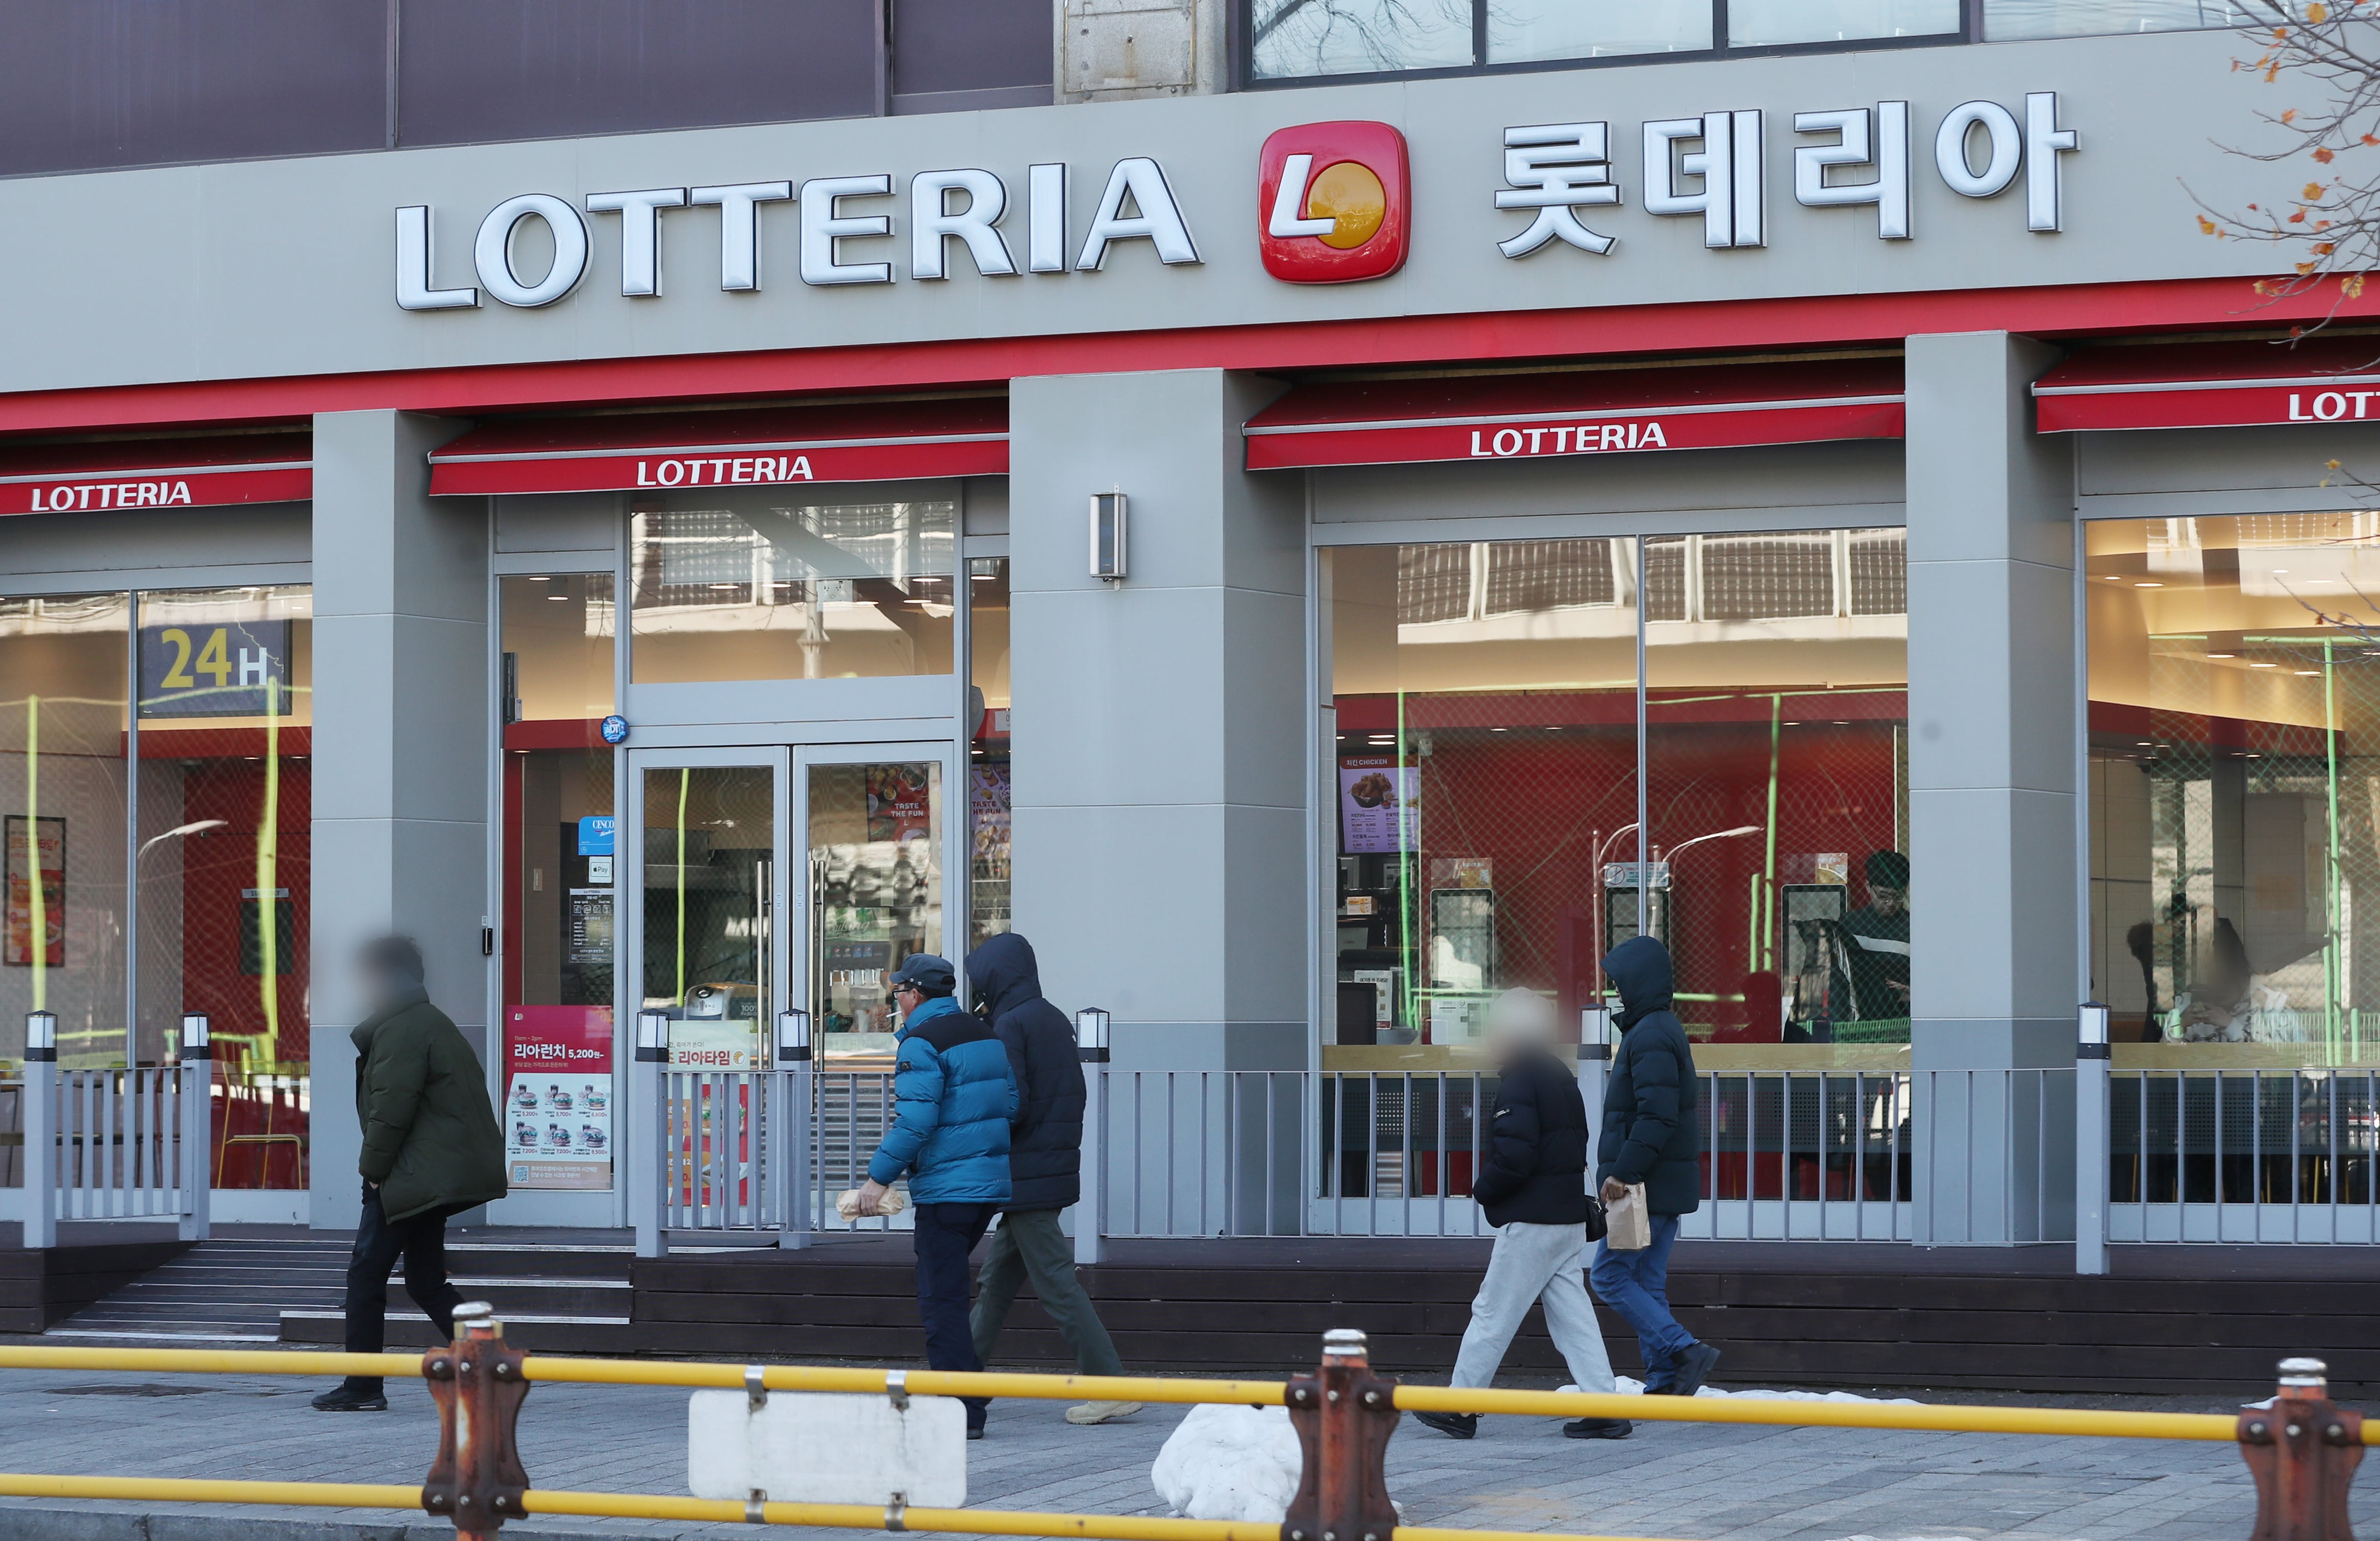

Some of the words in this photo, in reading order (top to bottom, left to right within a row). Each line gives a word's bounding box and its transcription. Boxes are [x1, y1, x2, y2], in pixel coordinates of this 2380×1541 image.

[1494, 91, 2081, 260] 롯데리아
[395, 156, 1205, 311] LOTTERIA
[2289, 391, 2380, 420] LOT
[1471, 421, 1667, 458] LOTTERIA
[637, 455, 815, 487] LOTTERIA
[31, 481, 192, 511] LOTTERIA
[605, 724, 620, 734] ADT
[593, 819, 614, 829] CESCO
[514, 1044, 566, 1059] 리아런치
[679, 1051, 729, 1066] 리아타임
